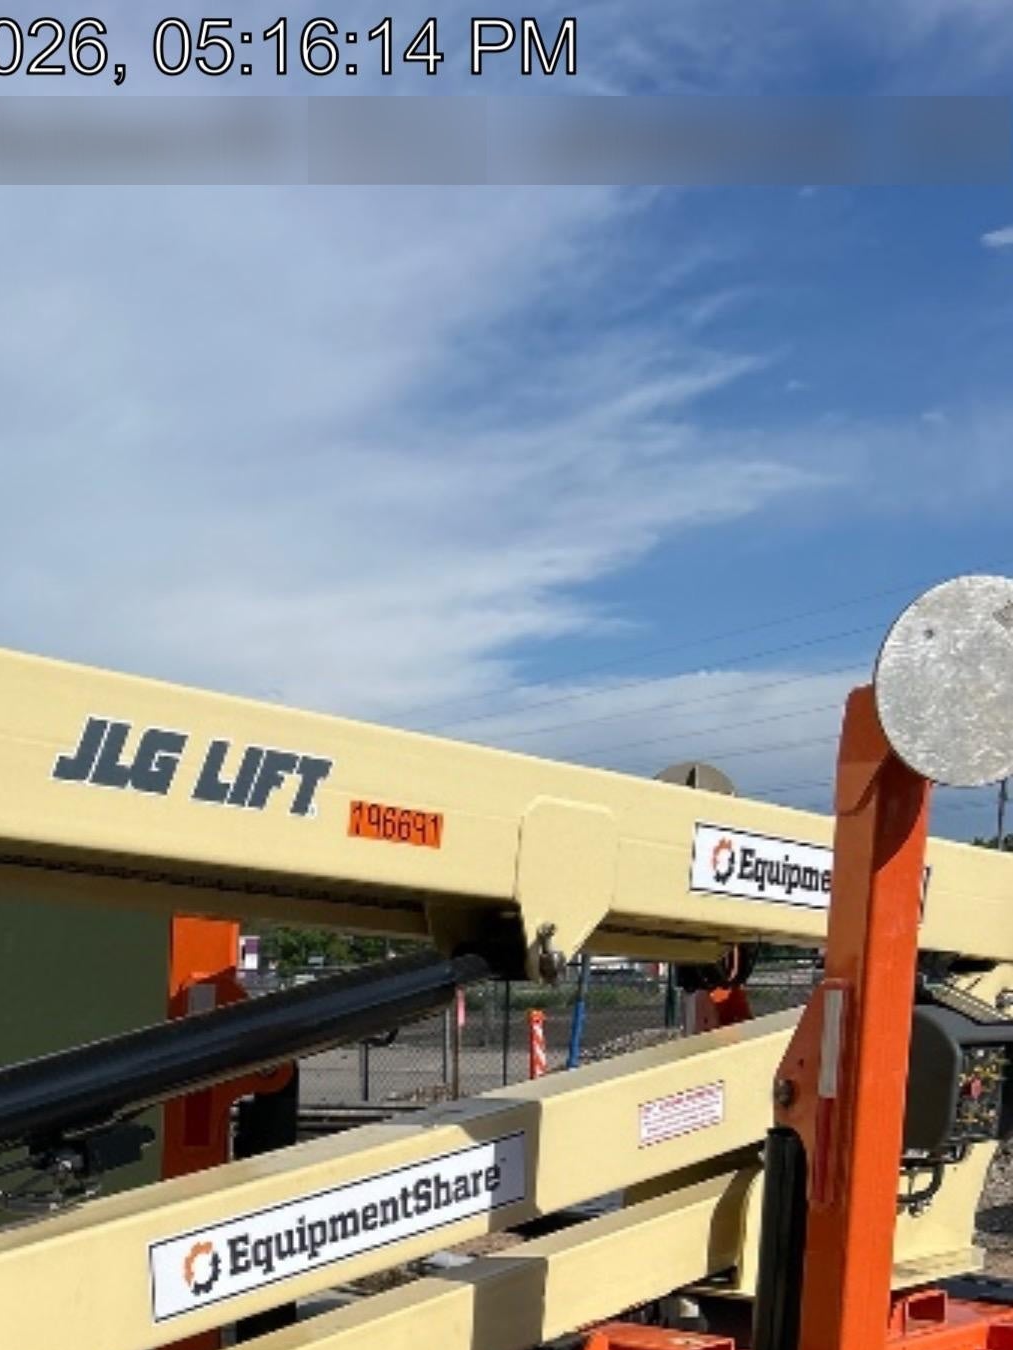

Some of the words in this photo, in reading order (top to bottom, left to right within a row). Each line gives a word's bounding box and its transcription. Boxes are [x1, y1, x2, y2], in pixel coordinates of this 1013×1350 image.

[53, 716, 188, 795] JLG
[192, 739, 333, 816] LIFT
[352, 801, 439, 846] 196691
[736, 847, 831, 895] Equipme
[226, 1162, 502, 1276] EquipmentShare
